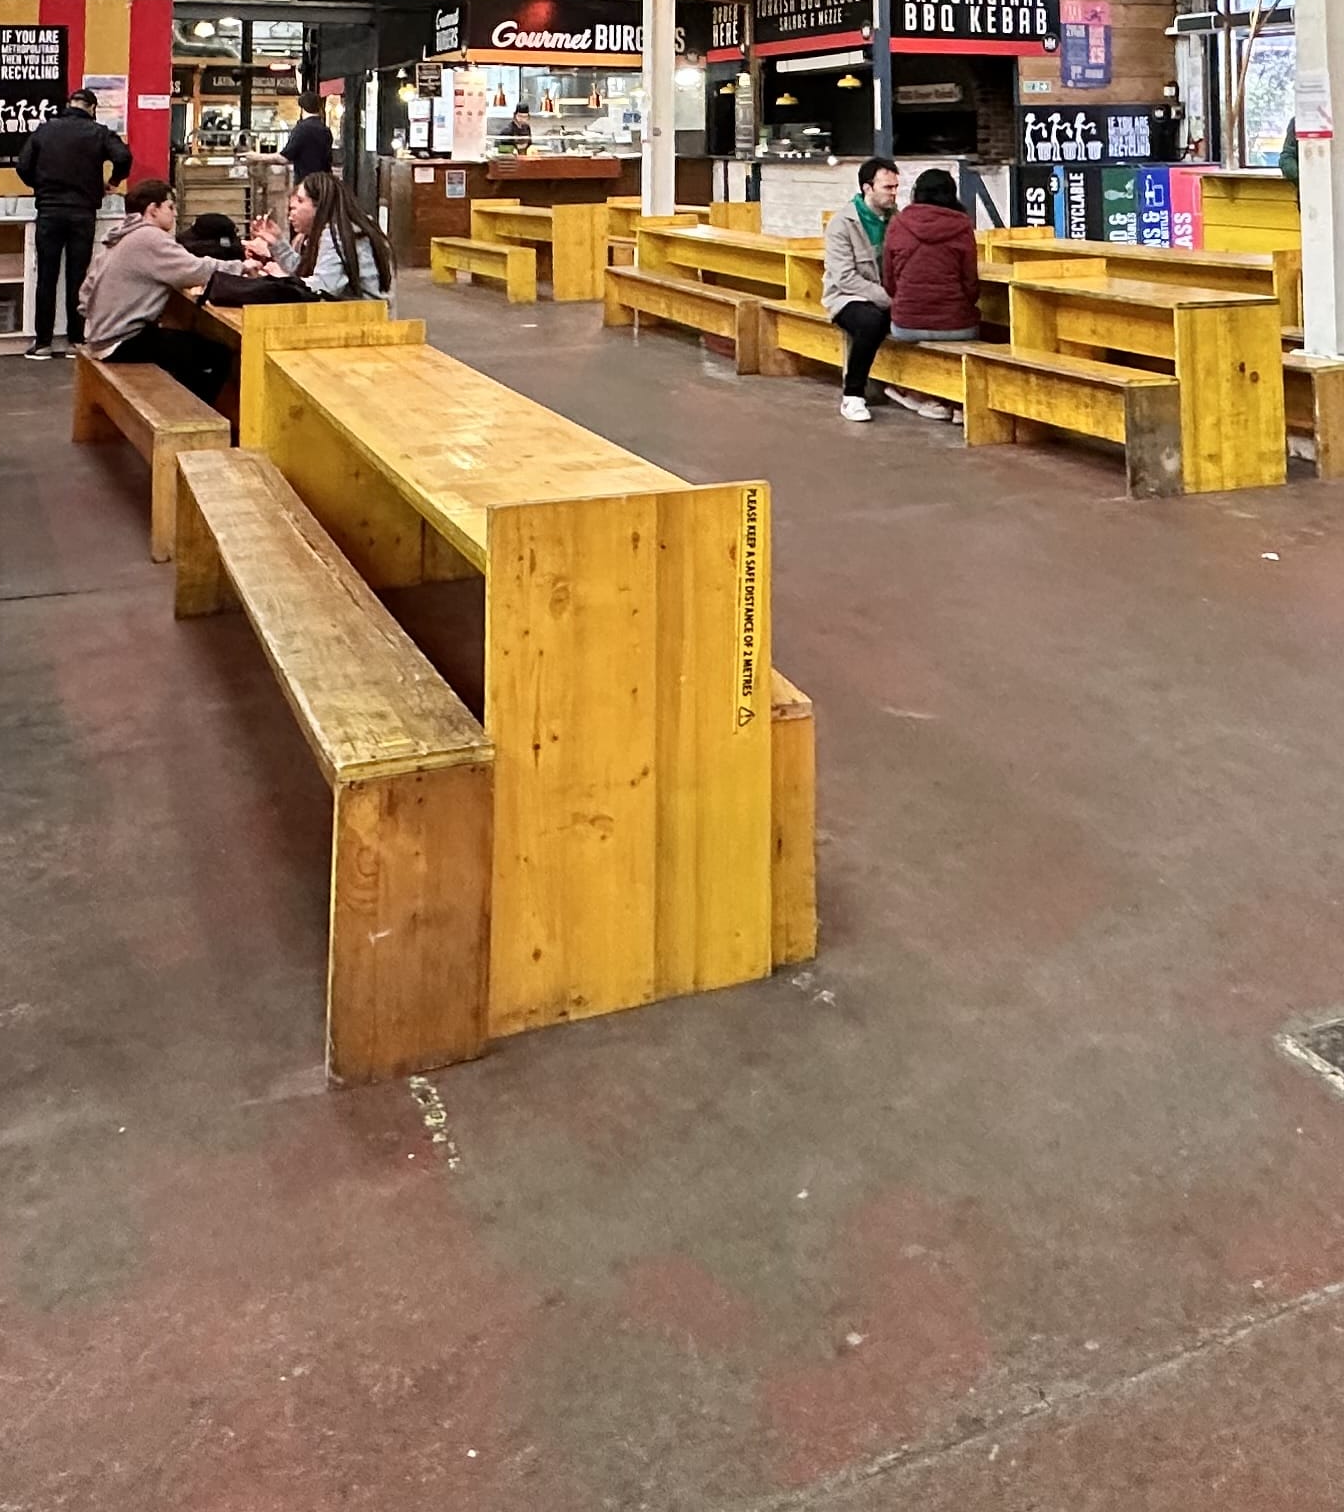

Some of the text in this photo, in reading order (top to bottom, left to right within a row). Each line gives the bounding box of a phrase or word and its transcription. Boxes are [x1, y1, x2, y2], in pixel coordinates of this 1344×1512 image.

[779, 13, 807, 32] SALADS
[818, 7, 843, 25] MEZZE
[904, 2, 954, 32] BBQ
[969, 5, 1048, 35] KEBAB
[2, 29, 59, 44] IF YOU ARE
[491, 21, 686, 53] Gourmet BURGS
[712, 21, 739, 47] HERE
[2, 54, 59, 65] THEN YOU LIKE
[1, 65, 59, 80] RECYCLING
[1069, 172, 1086, 241] ECYCLABLE
[746, 488, 757, 523] PLEASE
[745, 525, 756, 548] KEEP
[746, 550, 755, 559] A
[745, 560, 755, 583] SAFE
[744, 585, 755, 633] DISTANCE
[743, 635, 754, 648] OF
[742, 659, 753, 697] METRES
